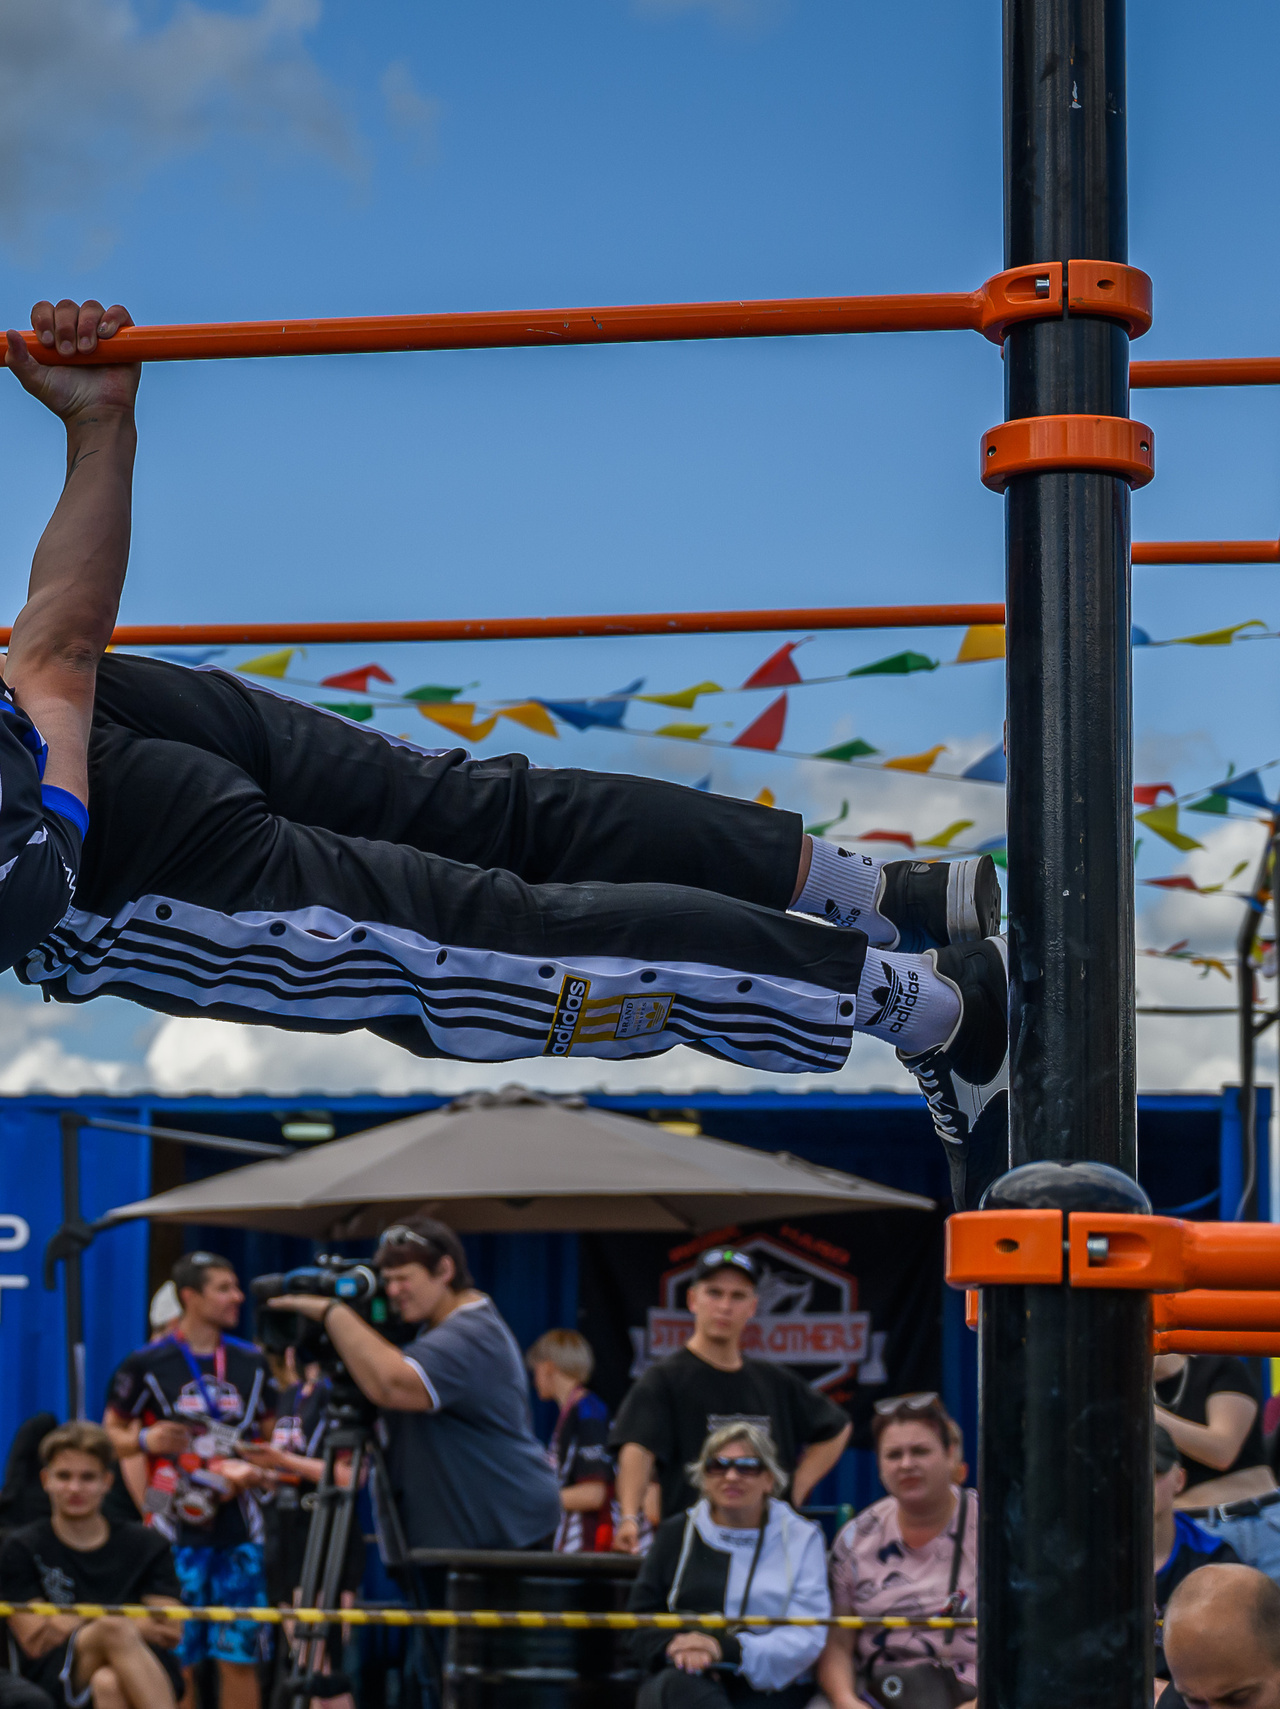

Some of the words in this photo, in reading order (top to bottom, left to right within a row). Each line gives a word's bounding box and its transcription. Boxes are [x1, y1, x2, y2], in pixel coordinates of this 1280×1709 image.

[552, 981, 586, 1055] adidas
[621, 1002, 634, 1033] BRAND
[890, 971, 919, 1033] adidas
